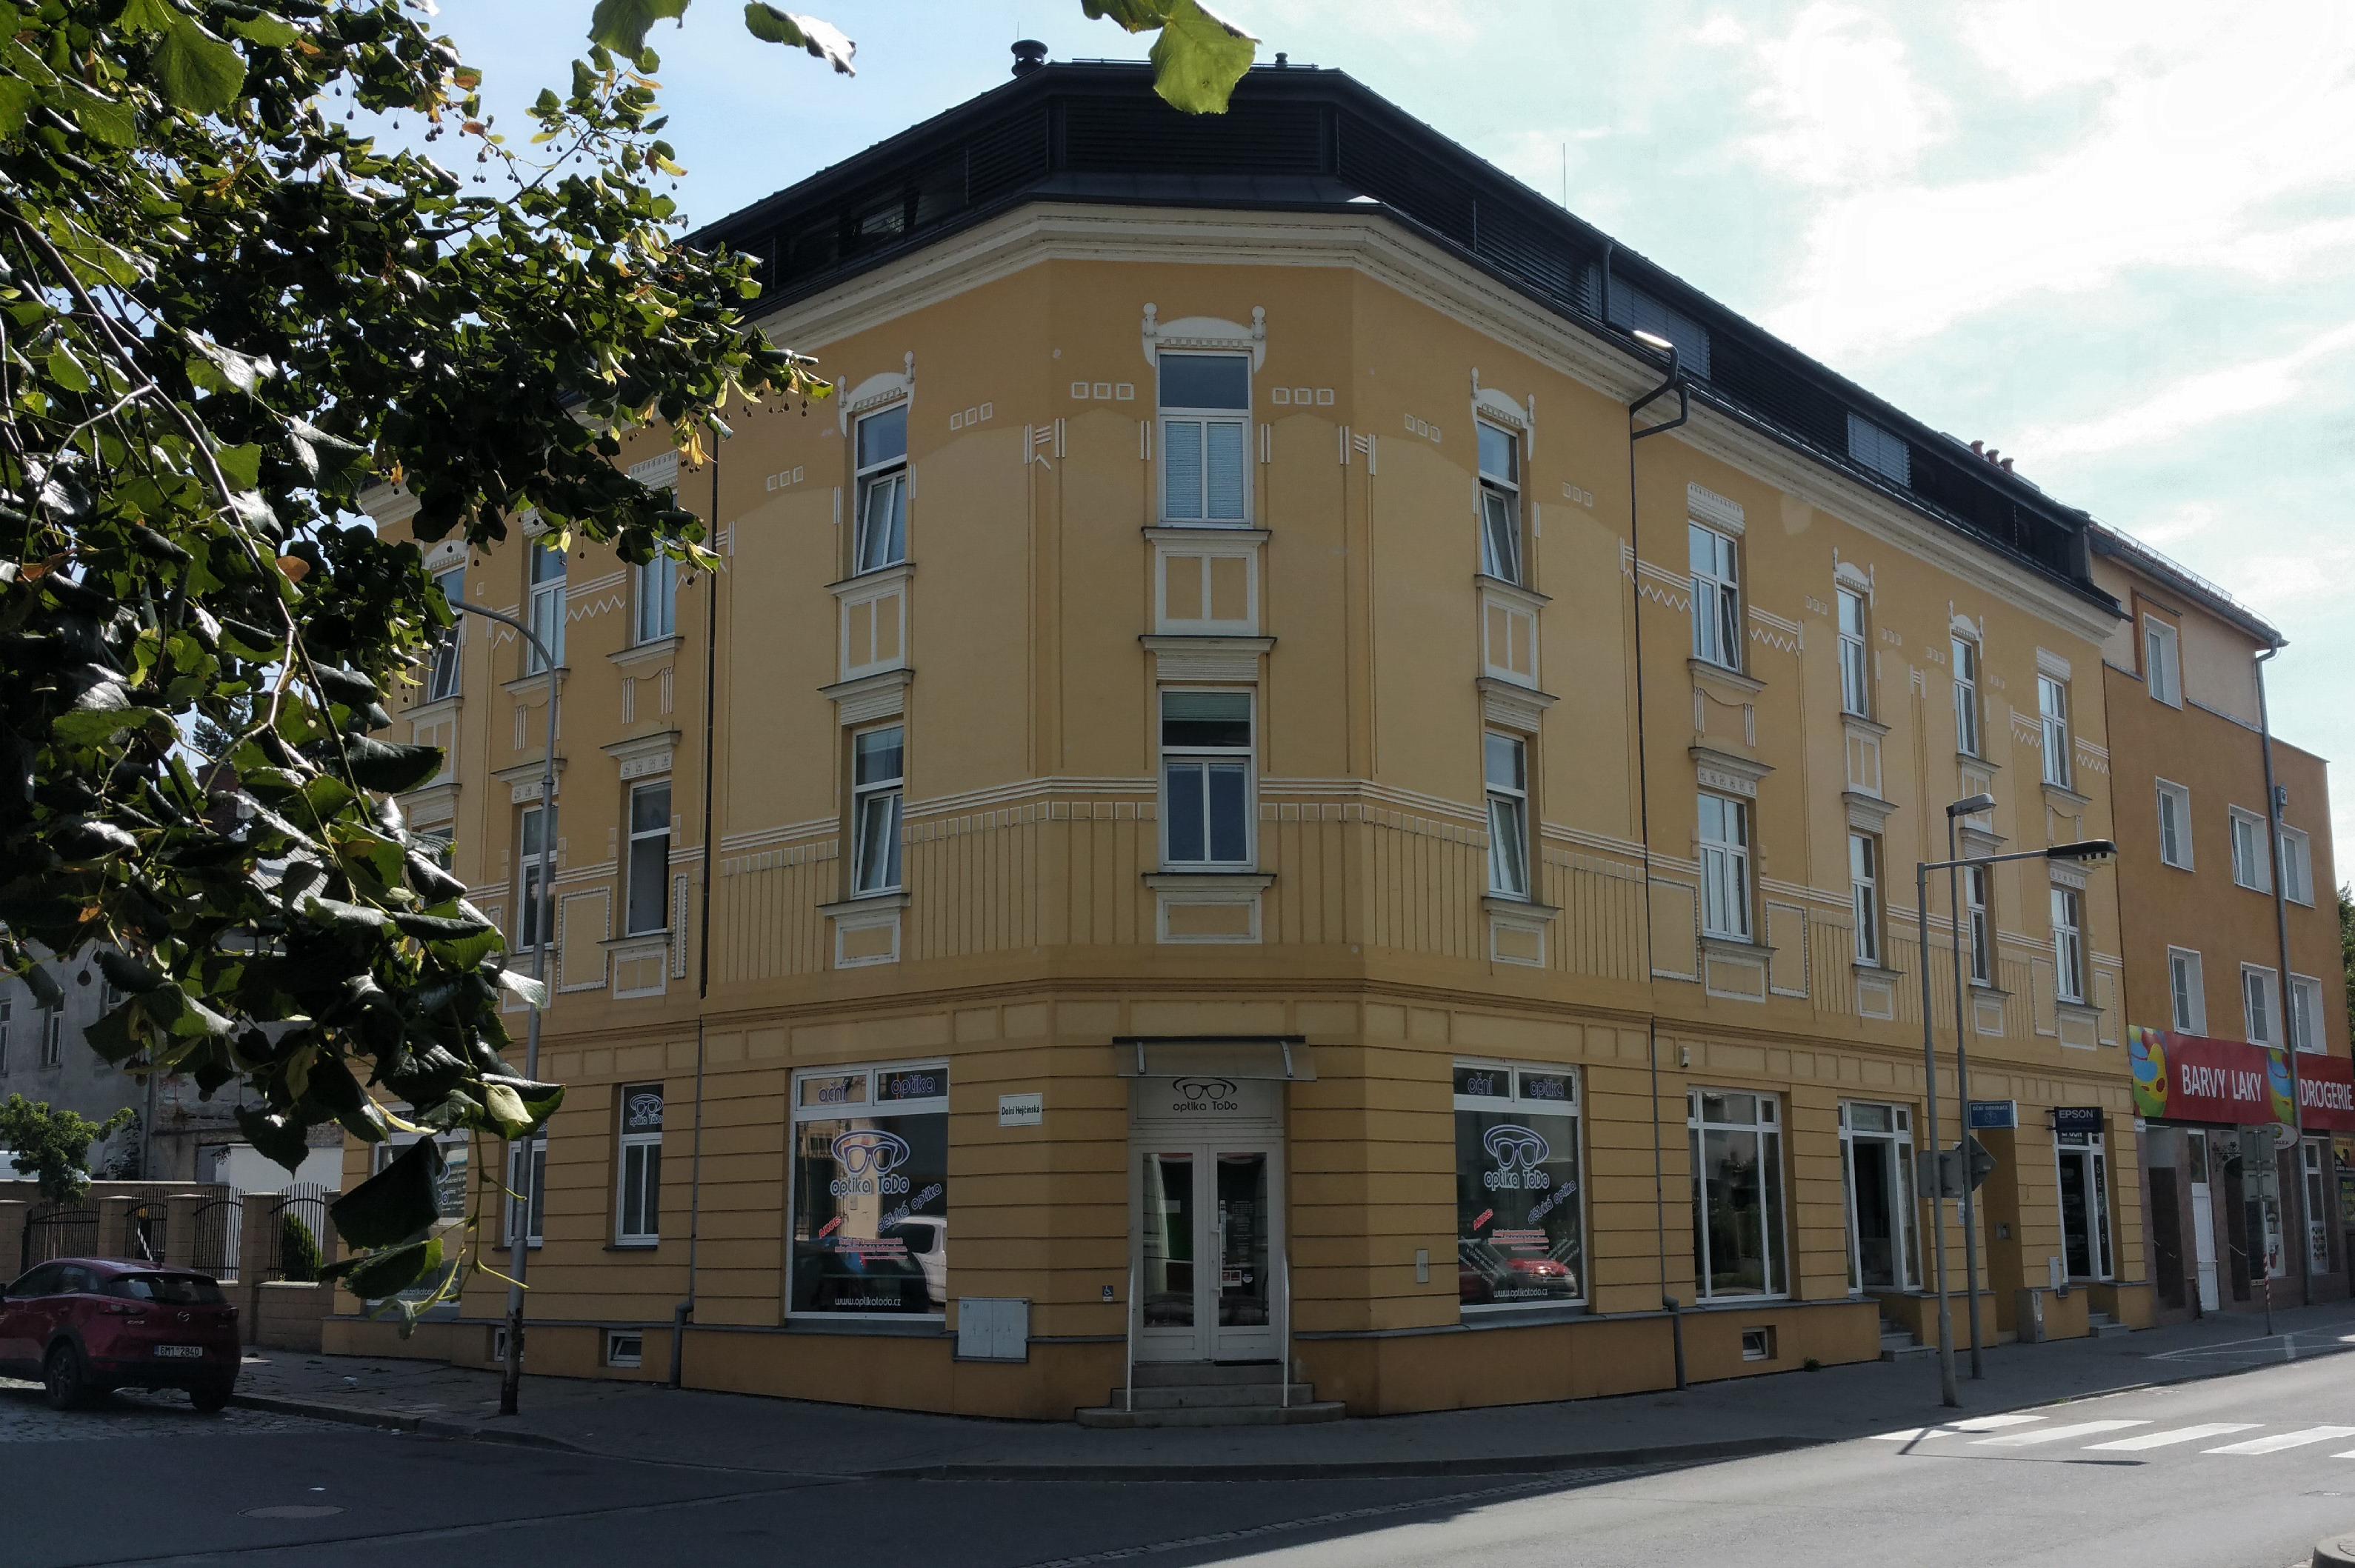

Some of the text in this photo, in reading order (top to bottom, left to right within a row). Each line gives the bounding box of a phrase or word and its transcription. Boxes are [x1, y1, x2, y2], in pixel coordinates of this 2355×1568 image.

[819, 1074, 936, 1103] oční optika
[1468, 1072, 1565, 1098] oční optika
[2181, 1064, 2262, 1102] BARVY LAKY
[2299, 1078, 2354, 1111] DROGERIE
[1002, 1106, 1015, 1115] Dolní
[1173, 1101, 1238, 1112] optika ToDo
[2059, 1110, 2093, 1118] EPSON
[830, 1174, 910, 1196] optika ToDo
[1484, 1169, 1550, 1191] optika ToDo
[878, 1183, 943, 1232] dětská optika
[1528, 1180, 1576, 1224] dětská optika
[835, 1296, 902, 1307] www.optikatodo.cz
[1493, 1287, 1548, 1298] www.optikatodo.cz
[180, 1347, 199, 1356] 2840
